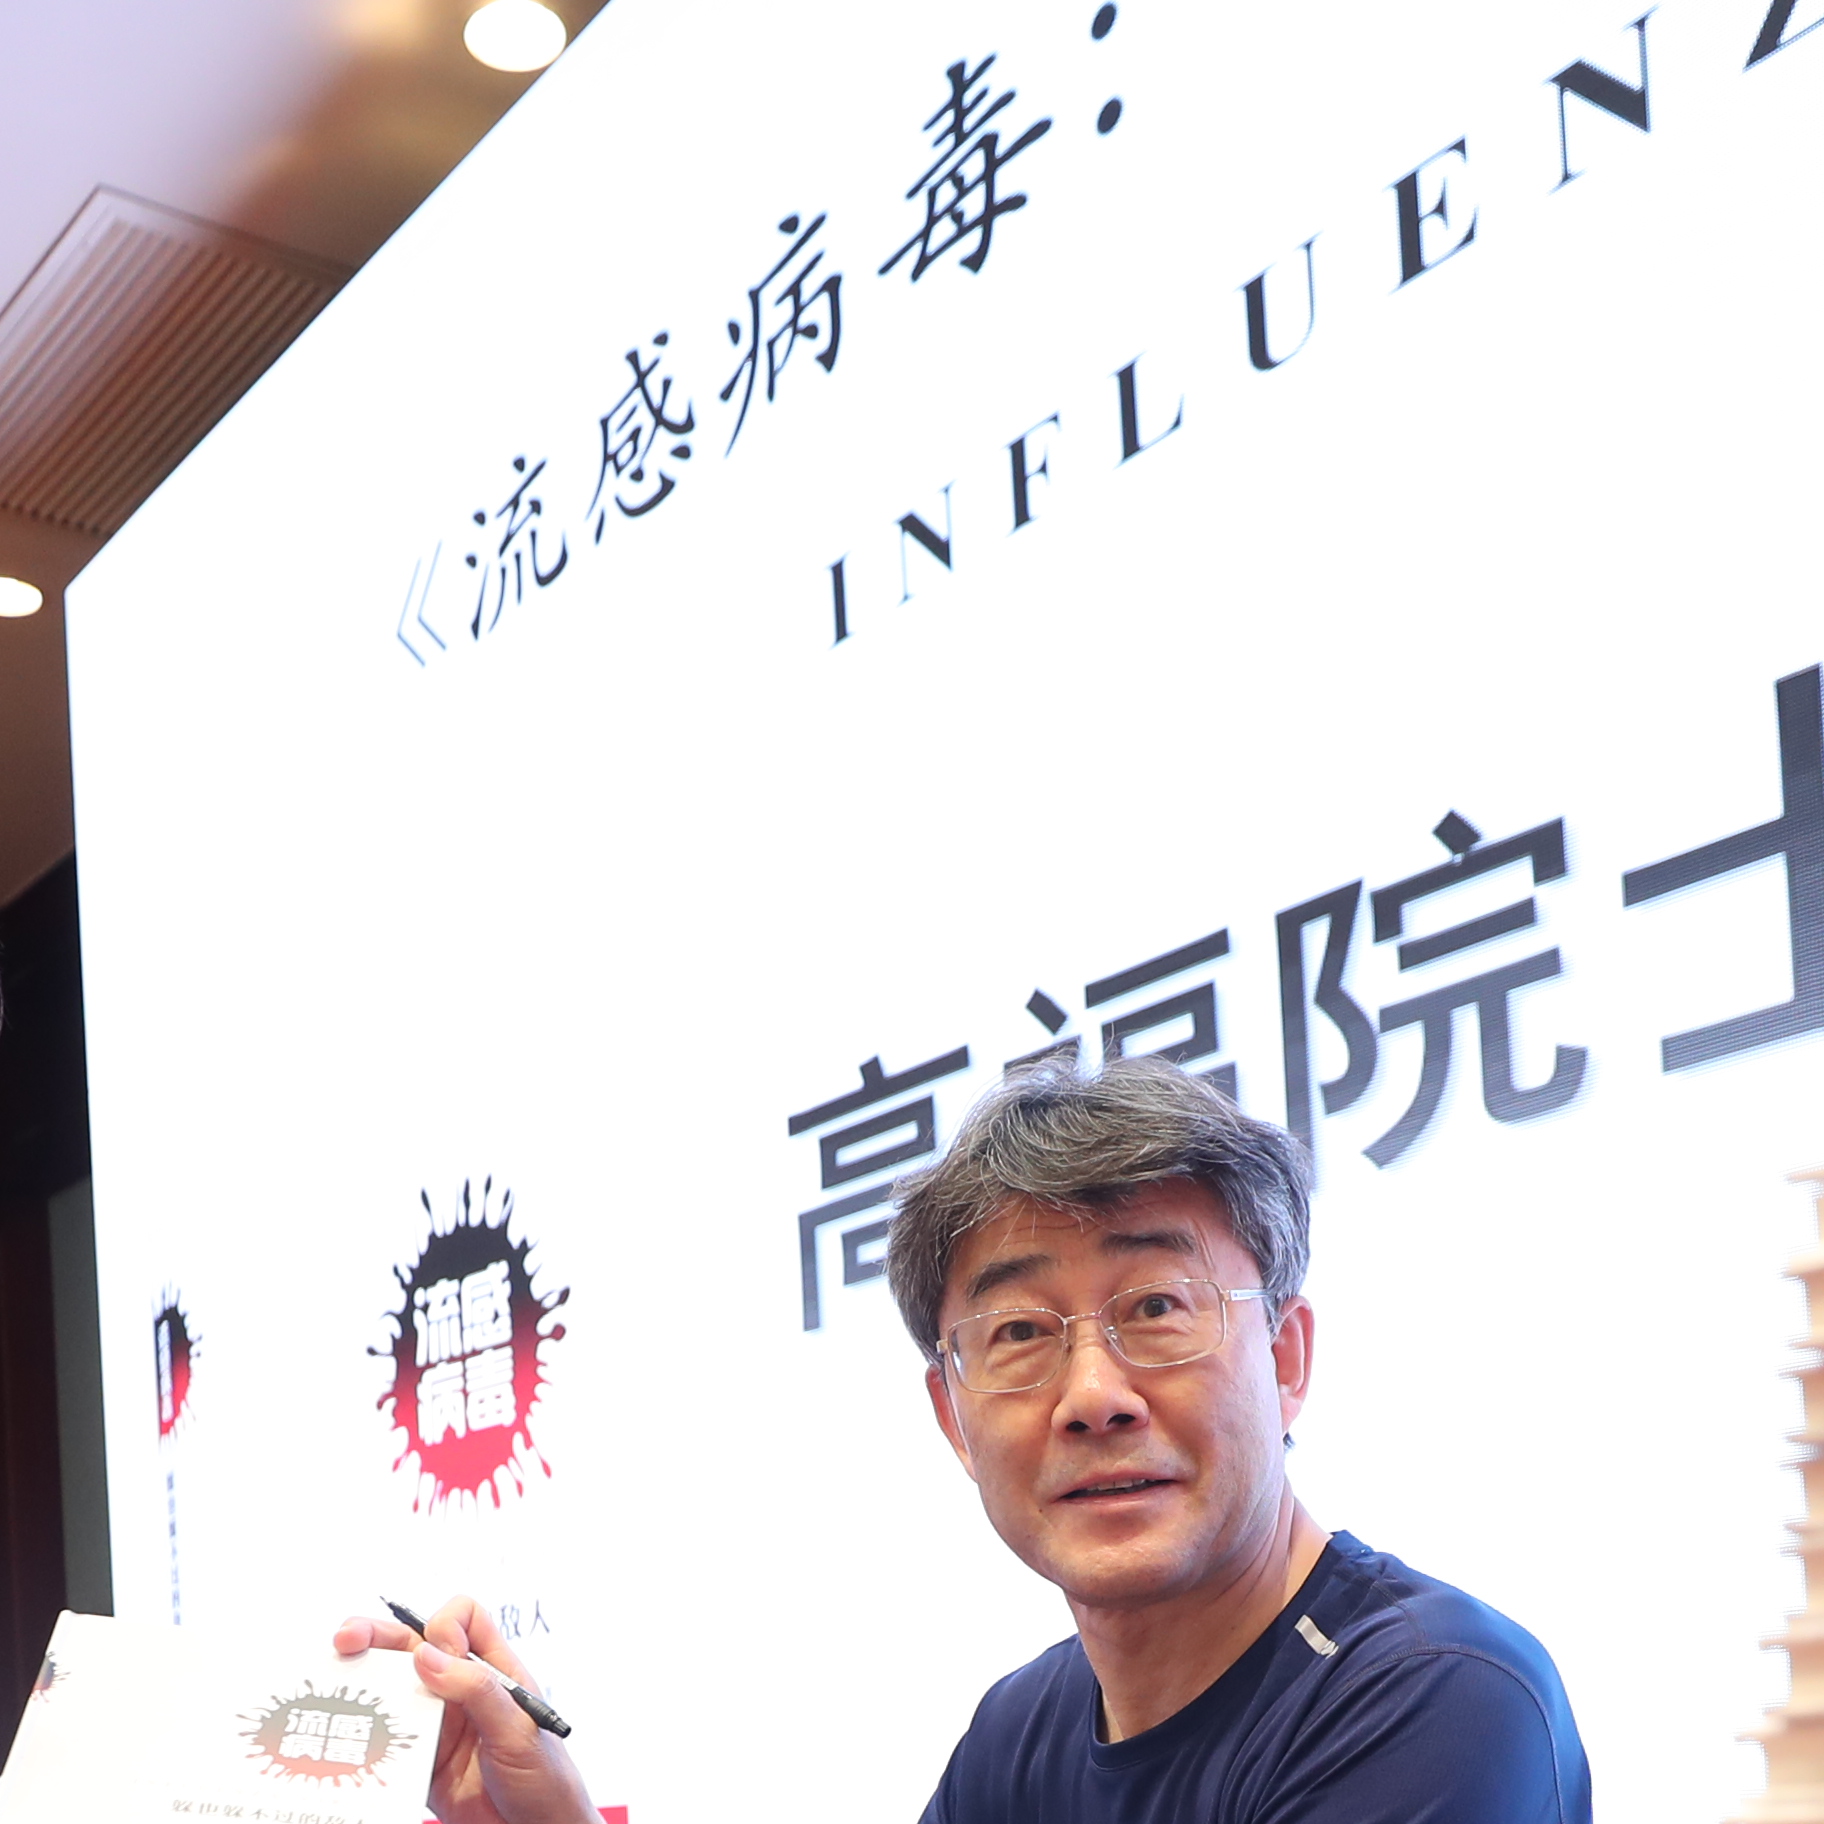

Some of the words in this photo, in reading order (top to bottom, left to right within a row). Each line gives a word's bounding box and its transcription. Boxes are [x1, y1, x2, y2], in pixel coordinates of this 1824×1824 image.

[413, 1259, 514, 1368] 流感
[415, 1346, 517, 1446] 病毒
[489, 1599, 550, 1640] 敌人
[284, 1707, 374, 1741] 流感
[278, 1733, 370, 1766] 病毒
